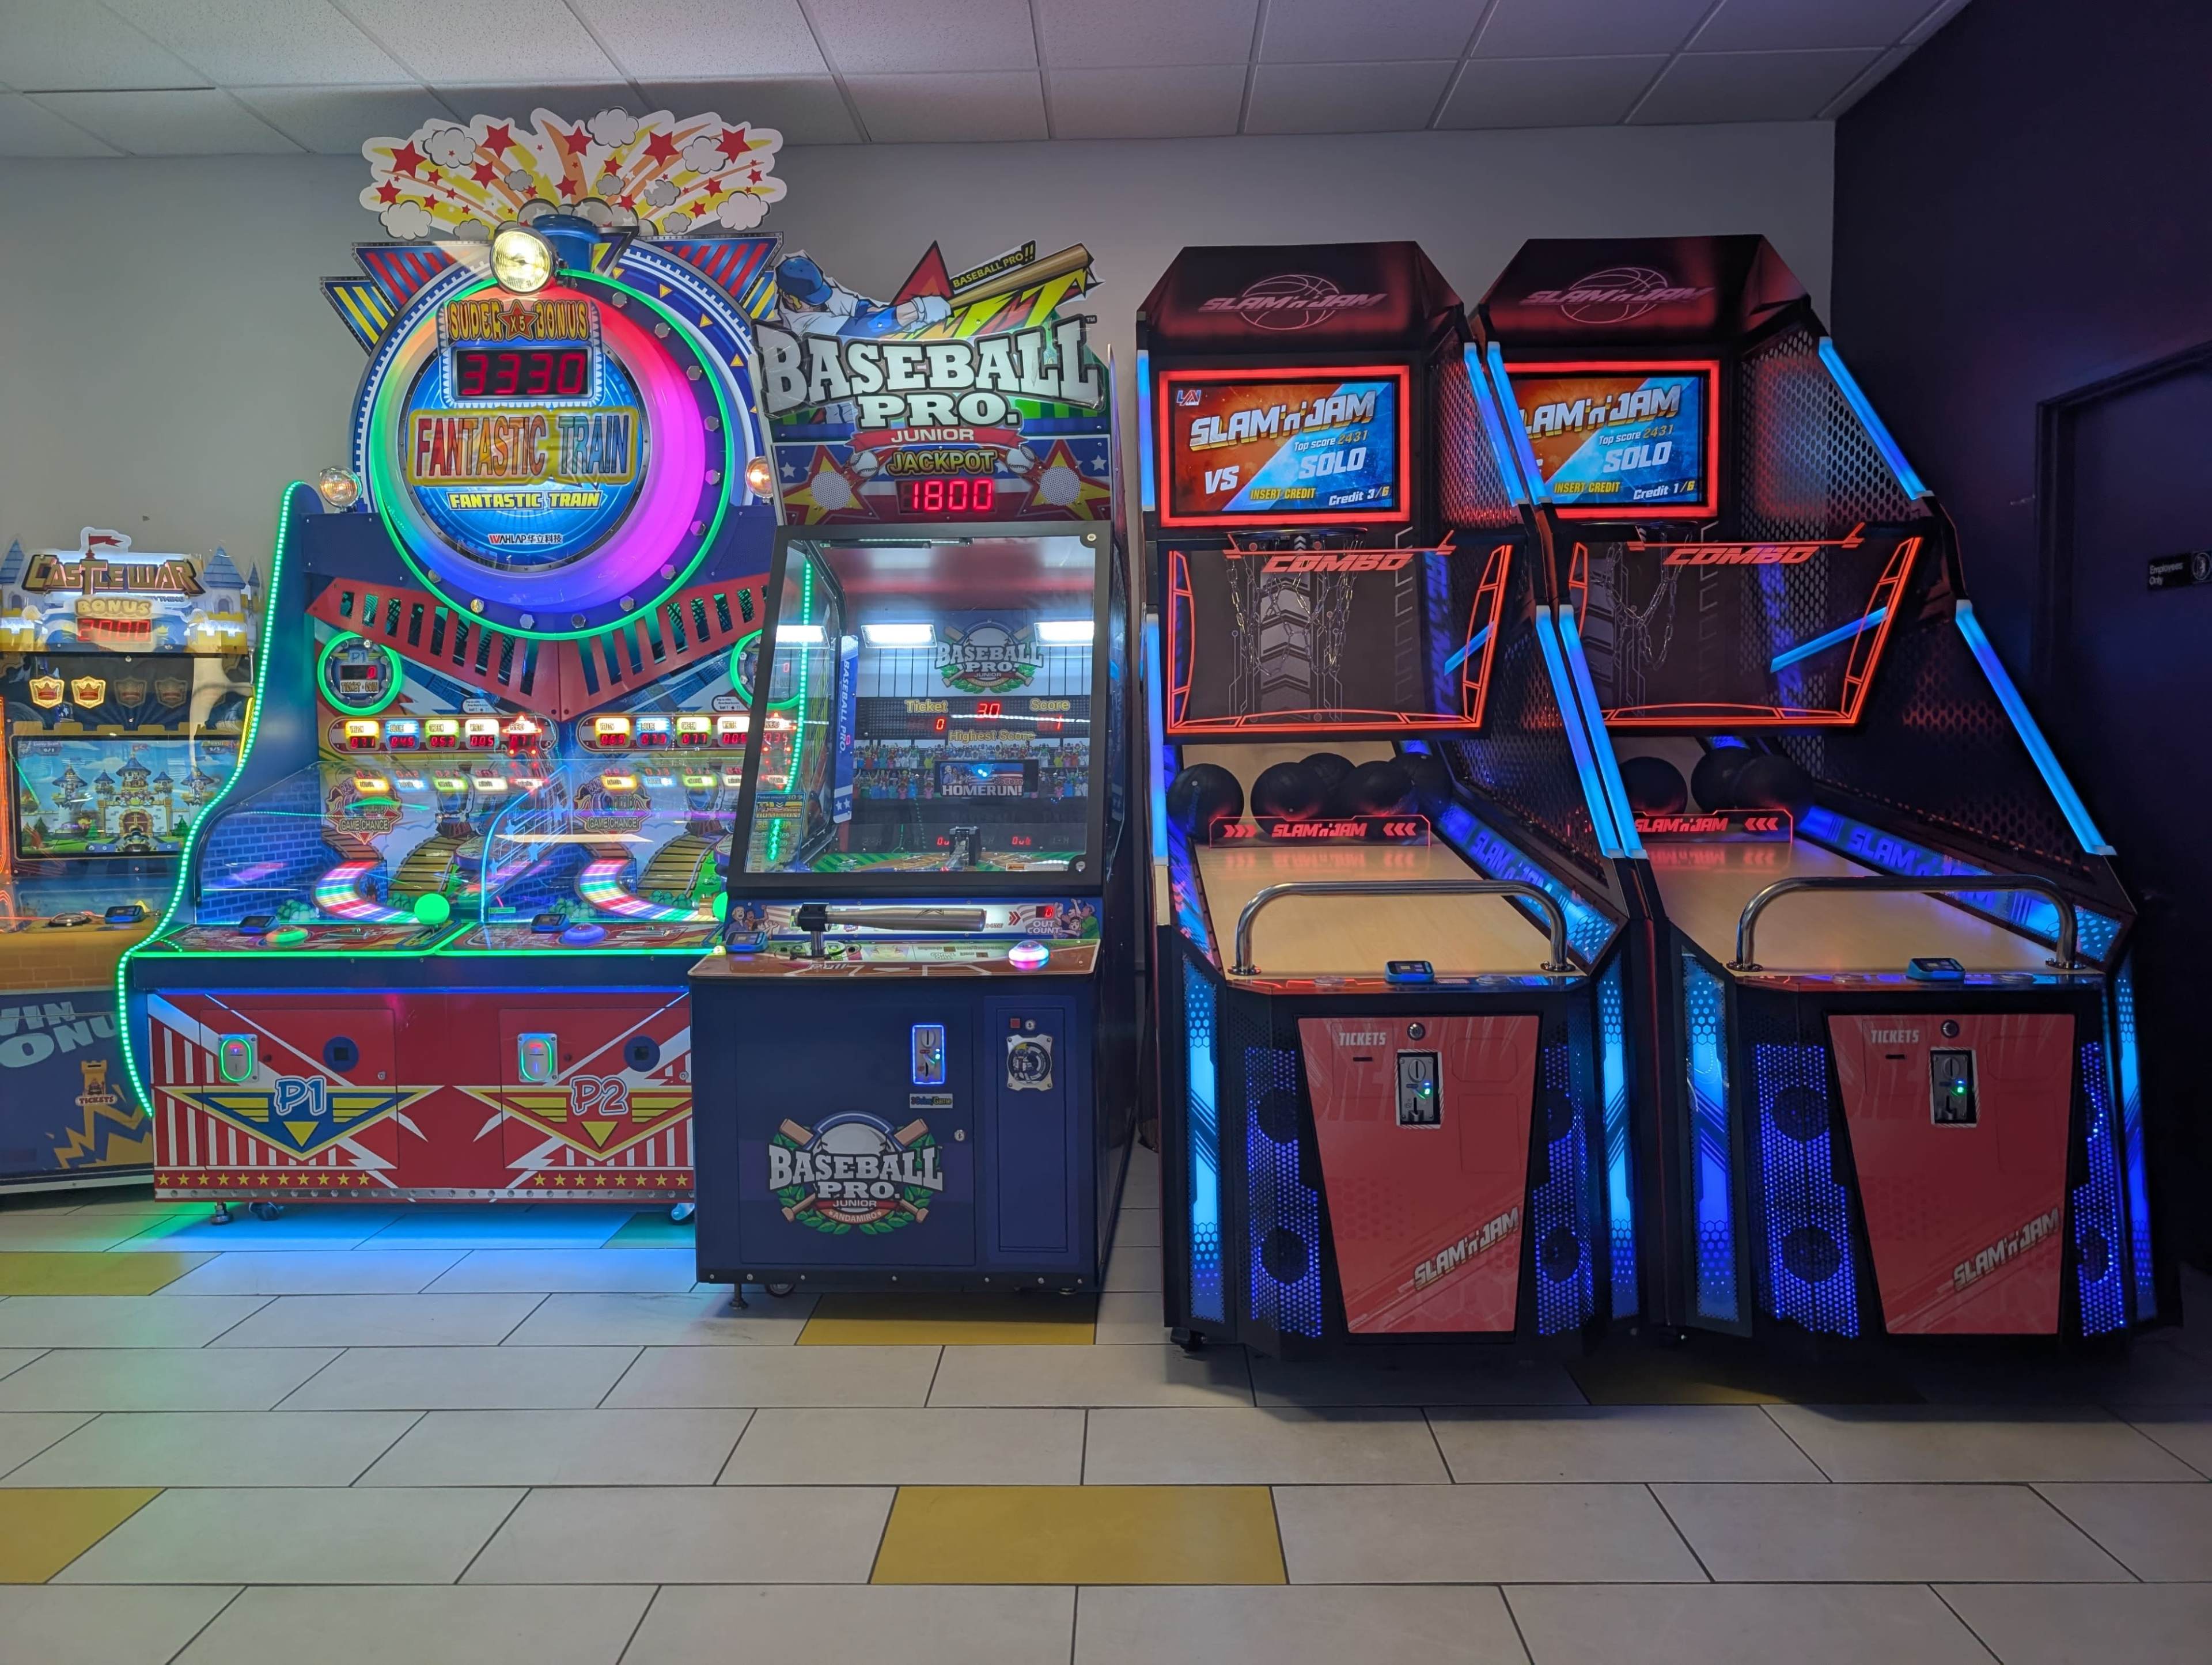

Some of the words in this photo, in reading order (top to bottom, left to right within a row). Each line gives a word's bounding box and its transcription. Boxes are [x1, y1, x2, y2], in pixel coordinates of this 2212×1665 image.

[953, 259, 1003, 288] BASEBALL
[1003, 244, 1036, 267] PRO!!
[450, 302, 503, 341] SUPER
[461, 353, 586, 395] 3330
[753, 318, 1100, 414] BASEBALL
[858, 393, 1018, 426] PRO.
[891, 428, 975, 443] JUNIOR
[1294, 441, 1309, 452] Top
[1310, 438, 1336, 449] score
[1336, 430, 1368, 446] 2431
[1600, 435, 1613, 446] Top
[1615, 431, 1641, 442] score
[1643, 424, 1674, 438] 2431
[416, 415, 546, 477] FANTASTIC
[558, 415, 630, 476] TRAIN
[889, 450, 996, 473] JACKPOT
[1298, 447, 1367, 480] SOLO
[1603, 441, 1672, 473] SOLO
[1205, 465, 1240, 495] VS
[1554, 482, 1585, 493] INSERT
[1588, 481, 1620, 493] CREDIT
[449, 492, 542, 509] FANTASTIC
[549, 492, 600, 507] TRAIN
[914, 479, 994, 511] 1800
[1249, 488, 1281, 500] INSERT
[1284, 488, 1316, 499] CREDIT
[1328, 491, 1363, 506] Credit
[1633, 486, 1669, 500] Credit
[488, 534, 527, 544] WAHLAP
[527, 534, 563, 544] 华立科技
[1262, 553, 1415, 572] COMBO
[1662, 546, 1820, 566] COMBO
[25, 555, 124, 594] CASTLE
[127, 560, 203, 594] WAR
[2149, 562, 2184, 575] Employees
[2149, 576, 2164, 586] Only
[77, 599, 150, 615] BONUS
[78, 620, 150, 641] 2000
[935, 640, 1043, 668] BASEBALL
[367, 666, 377, 679] 0
[965, 662, 1016, 673] PRO.
[840, 661, 850, 722] BASEBALL
[905, 700, 949, 713] Ticket
[978, 703, 1001, 719] 30
[1029, 699, 1070, 711] Score
[935, 718, 945, 730] 0
[949, 730, 996, 744] Highest
[998, 730, 1036, 741] Score
[942, 784, 1023, 796] HOMERUN!
[340, 819, 360, 830] GAME
[360, 819, 389, 830] CHANCE
[589, 817, 609, 829] GAME
[609, 817, 637, 828] CHANCE
[1271, 822, 1368, 837] SLAM'n'JAM
[1338, 1032, 1387, 1046] TICKETS
[1870, 1029, 1919, 1044] TICKETS
[78, 1095, 114, 1104] TICKETS
[275, 1075, 327, 1116] P1
[570, 1075, 628, 1116] P2
[768, 1144, 943, 1192] BASEBALL
[817, 1181, 900, 1199] PRO.
[832, 1200, 877, 1208] JUNIOR
[833, 1212, 878, 1223] ANDAMIRO
